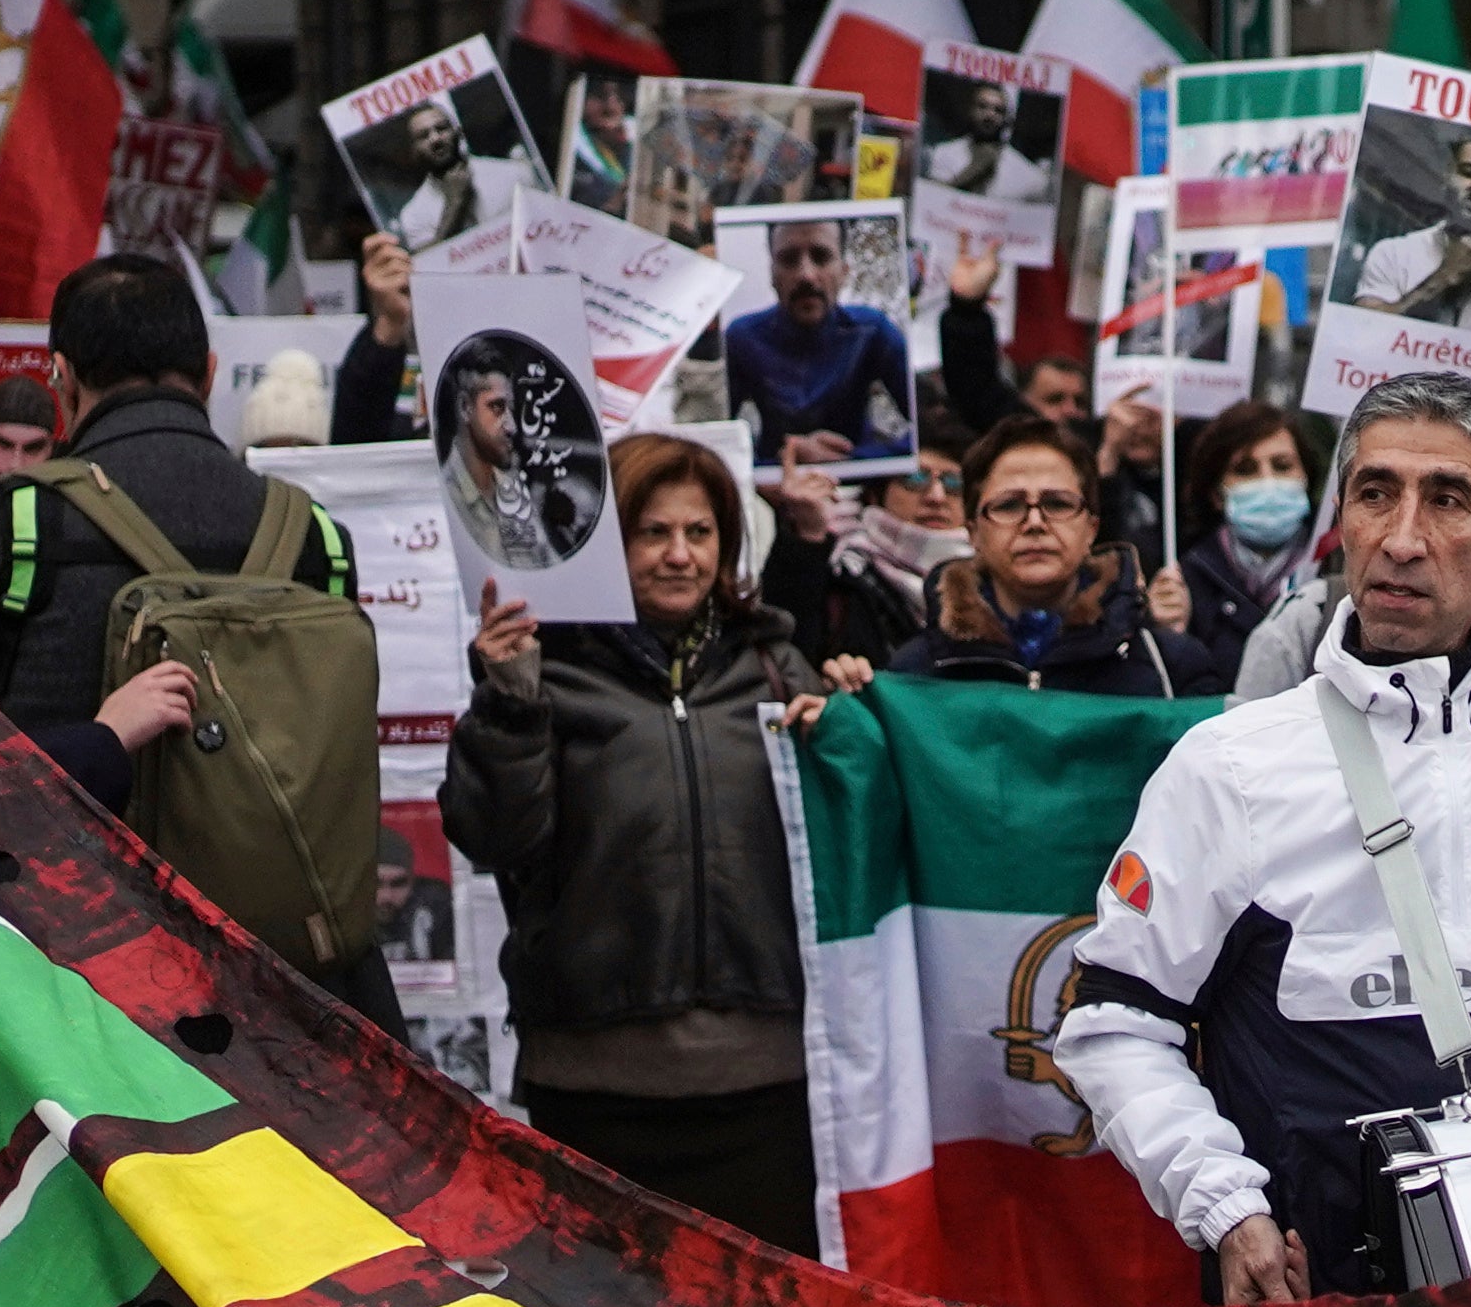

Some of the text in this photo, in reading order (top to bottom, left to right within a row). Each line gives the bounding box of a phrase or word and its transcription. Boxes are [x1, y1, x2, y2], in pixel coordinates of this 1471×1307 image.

[348, 48, 474, 128] TOOMAJ
[946, 44, 1051, 92] TOOMAJ
[121, 122, 216, 191] MEZ
